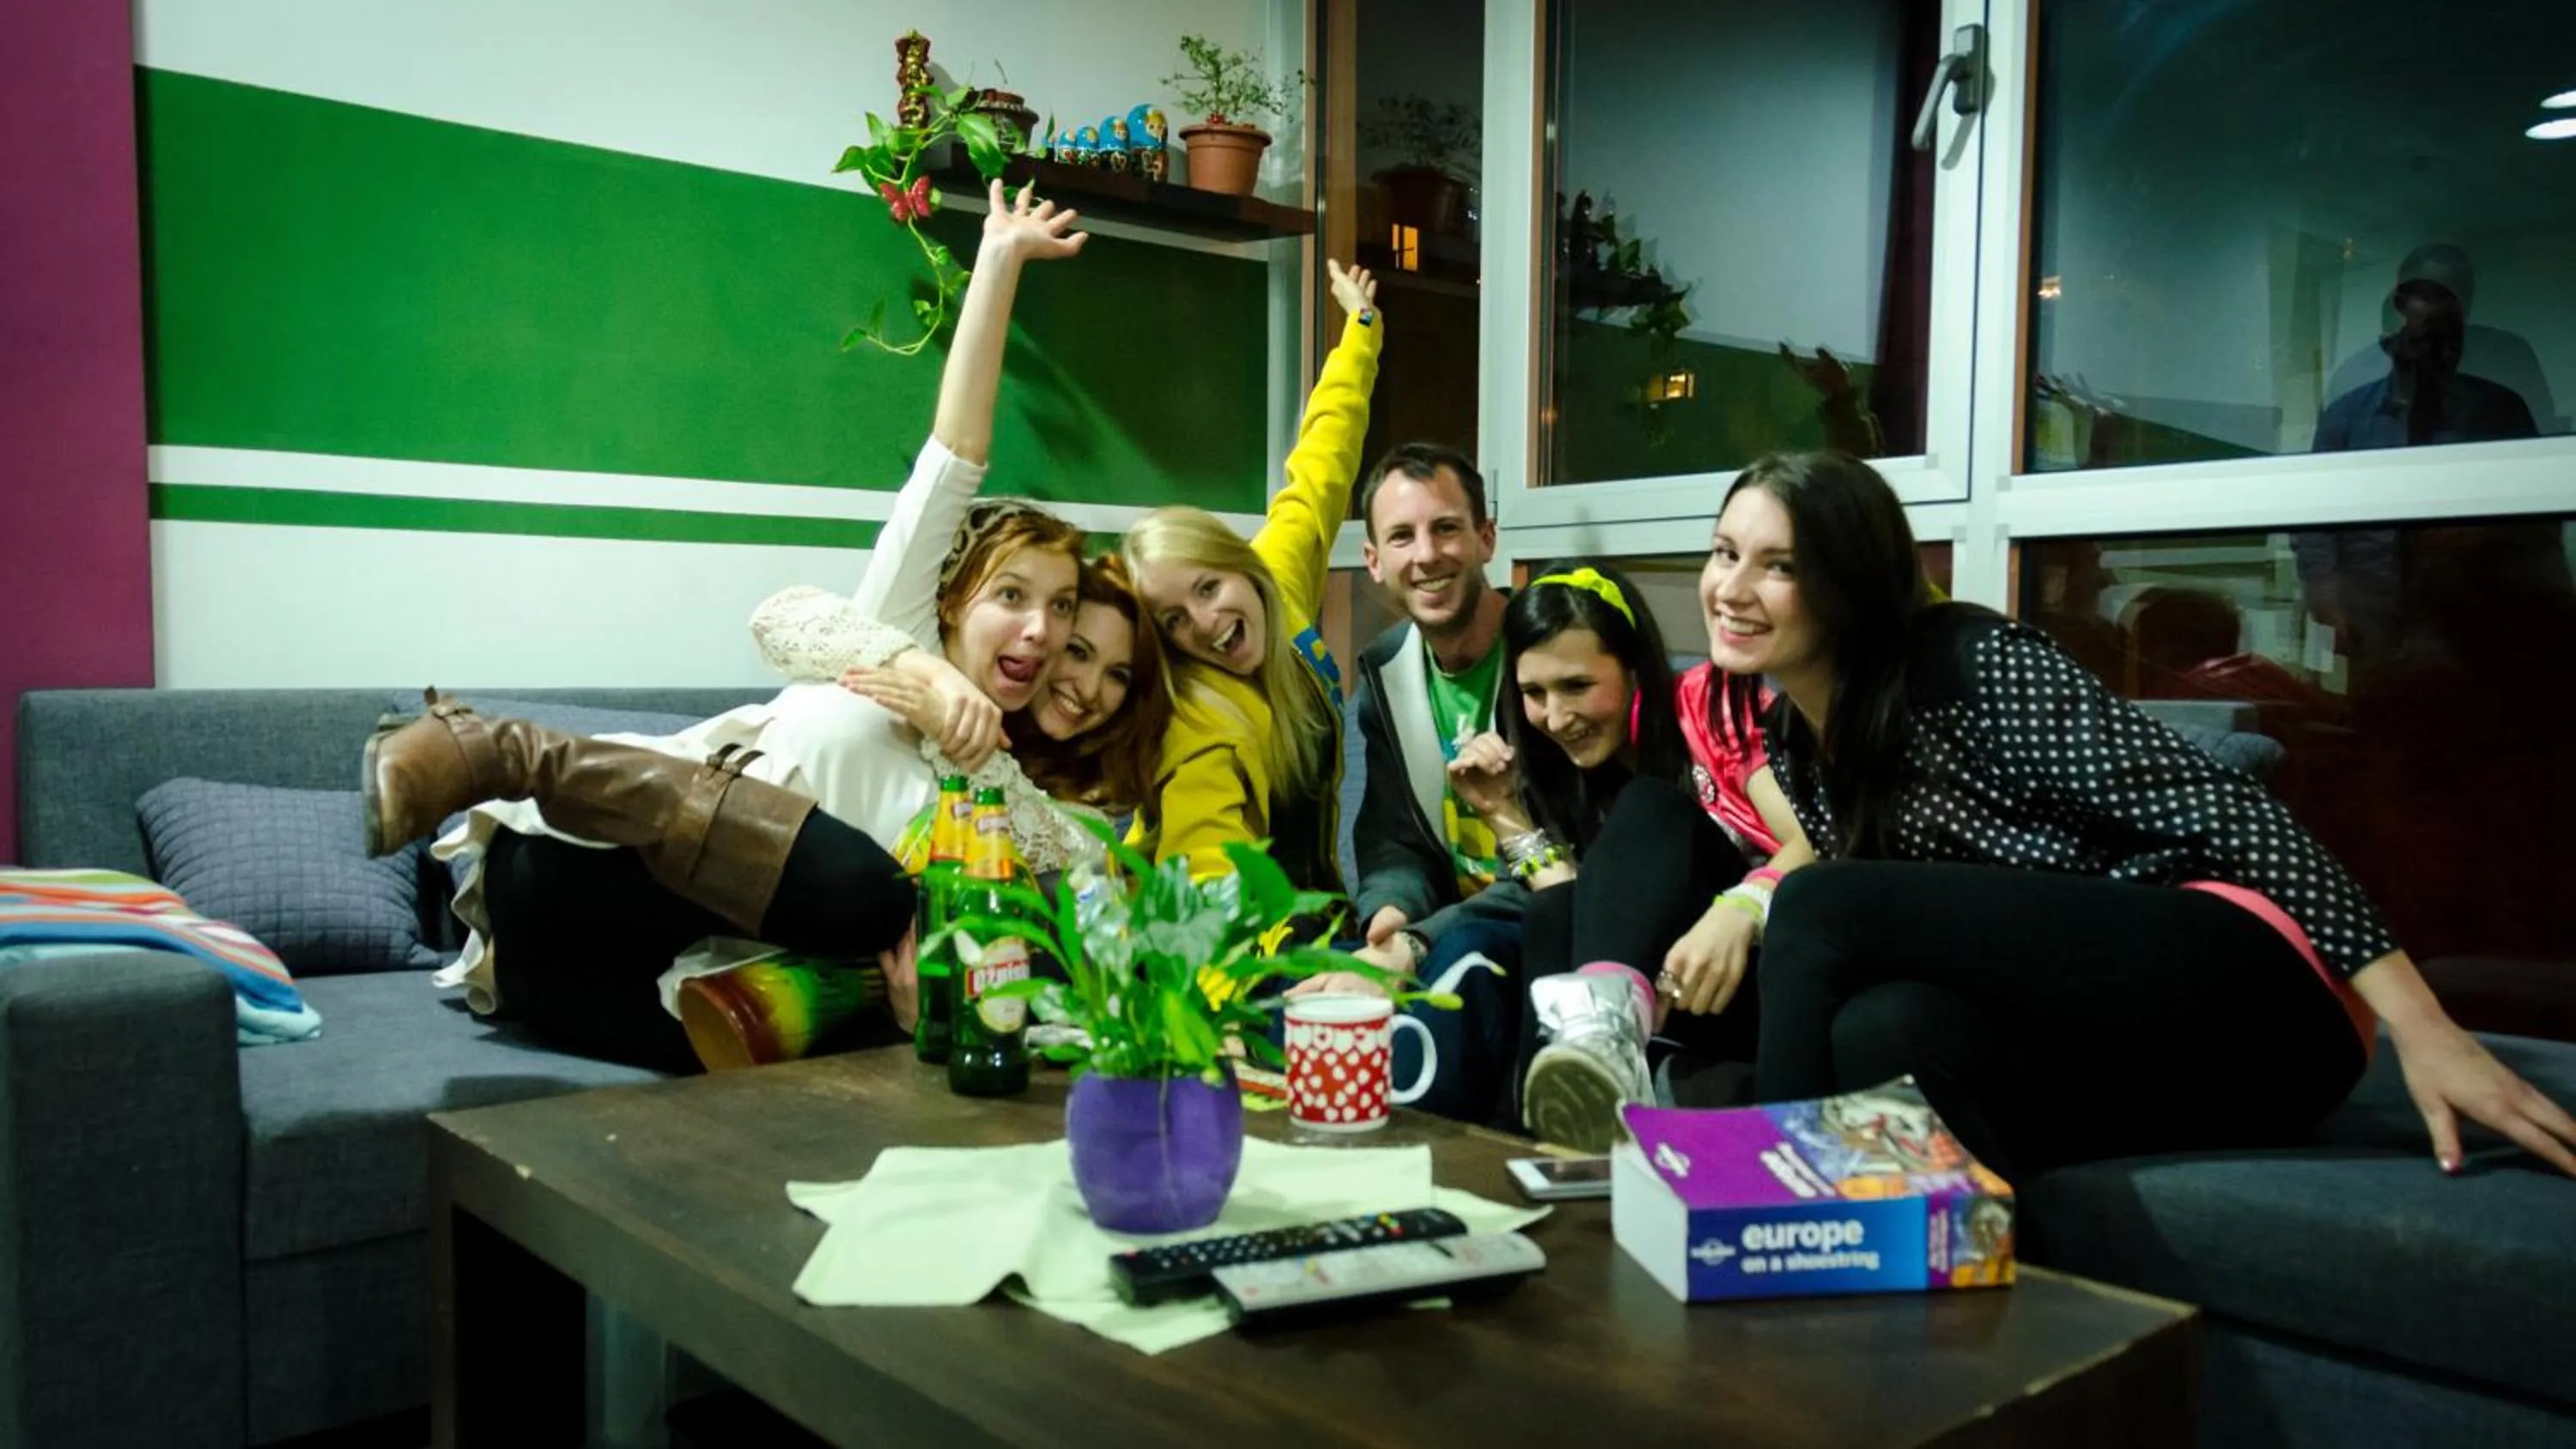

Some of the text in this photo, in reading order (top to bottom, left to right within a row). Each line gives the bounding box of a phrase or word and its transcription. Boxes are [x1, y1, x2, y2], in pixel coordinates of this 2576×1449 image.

[1741, 1220, 1864, 1253] europe
[1741, 1252, 1880, 1273] on a shoestring
